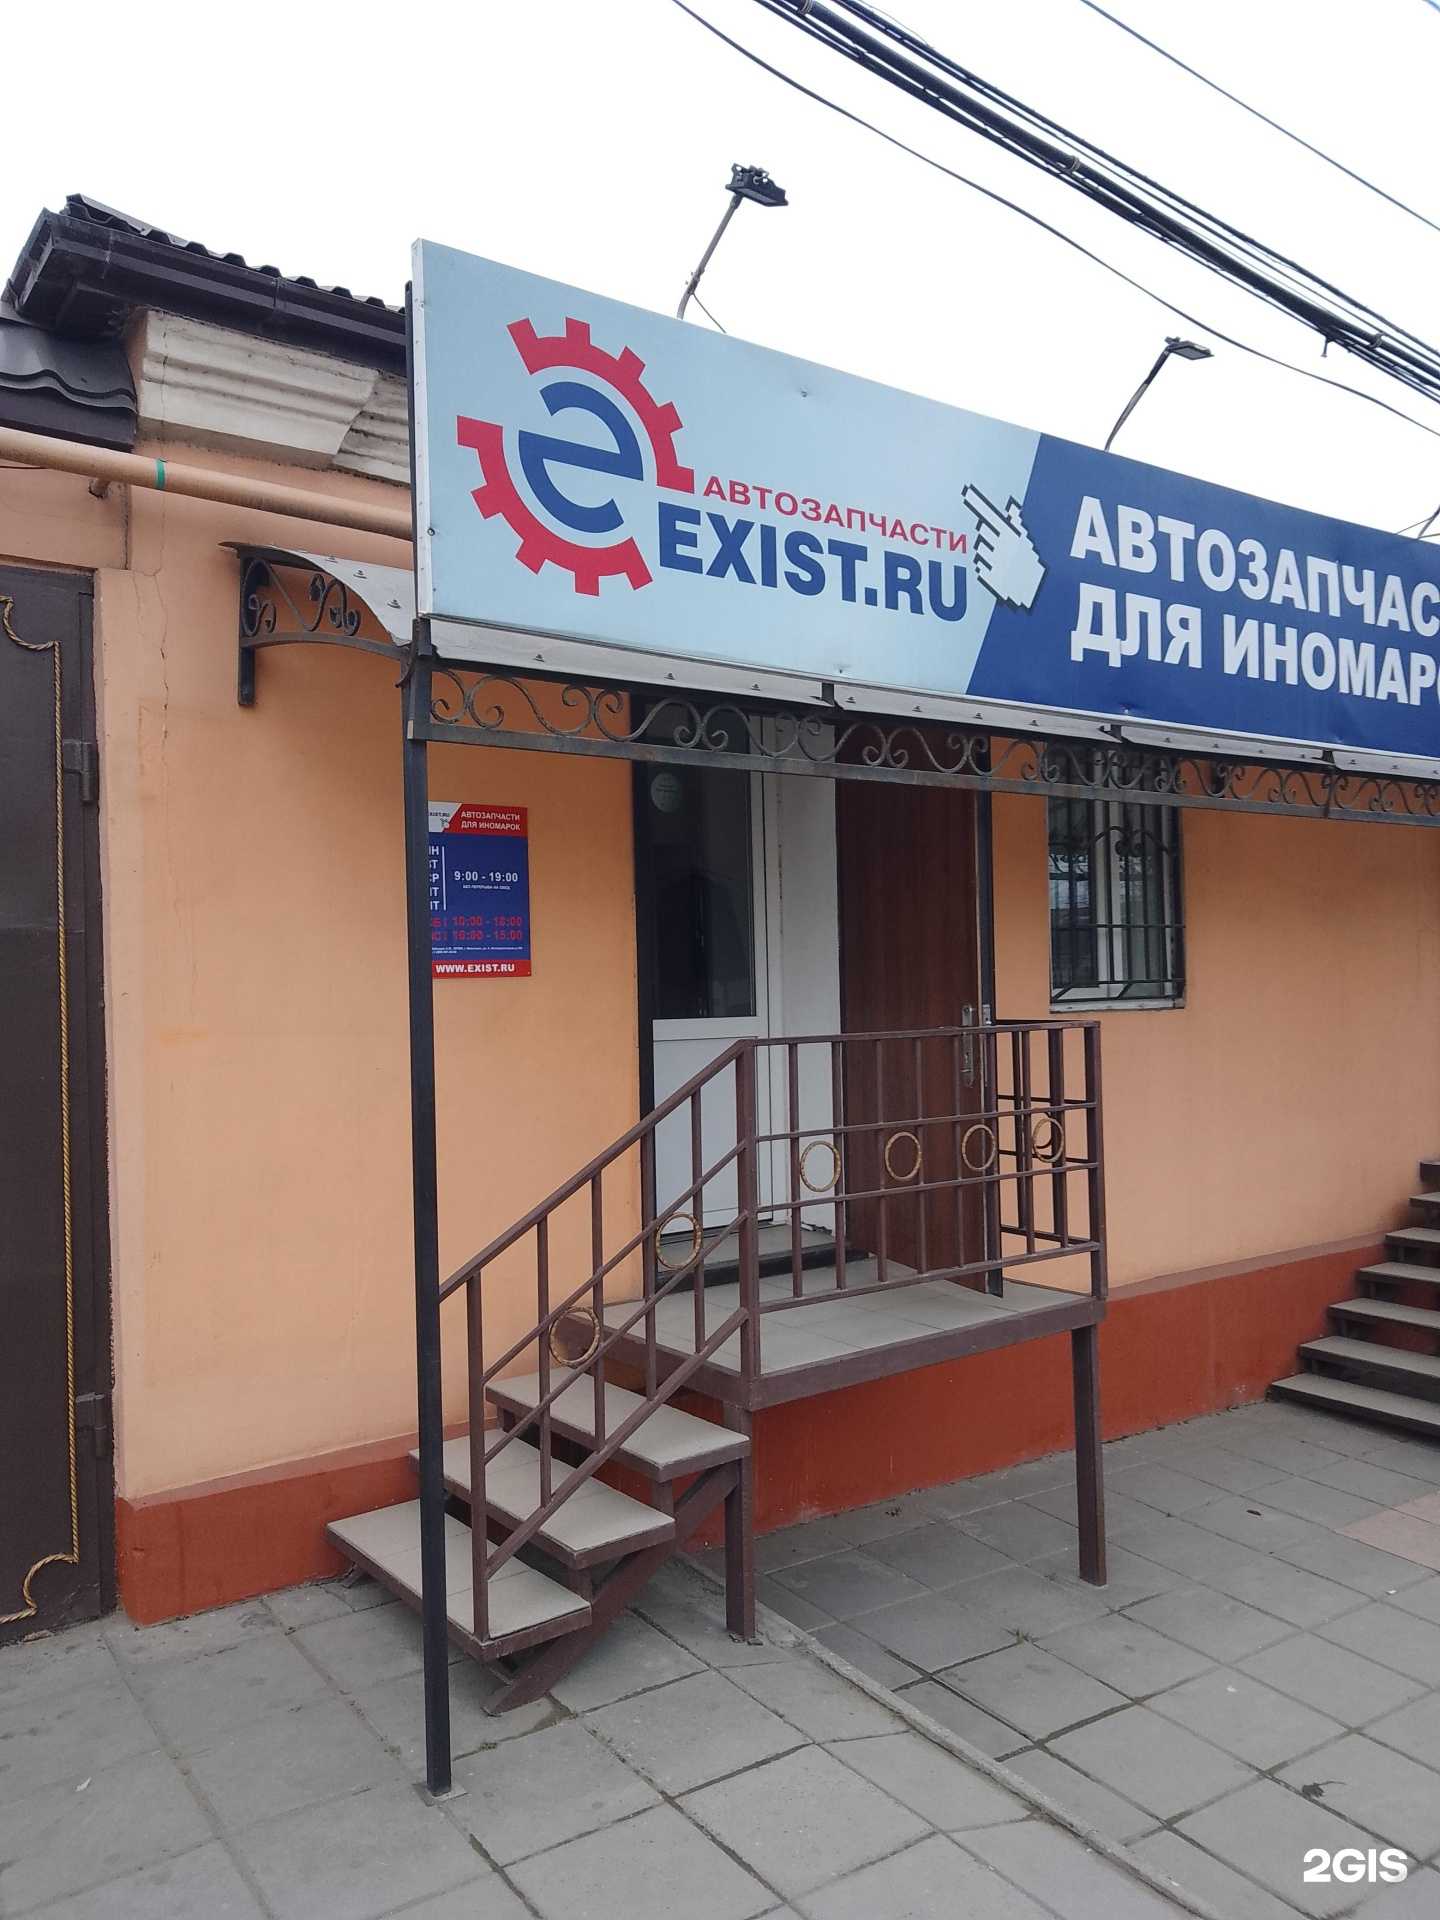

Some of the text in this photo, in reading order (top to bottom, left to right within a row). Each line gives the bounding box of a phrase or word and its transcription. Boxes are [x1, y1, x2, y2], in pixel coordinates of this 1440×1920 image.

[703, 475, 968, 554] АВТОЗАПЧАСТИ
[658, 501, 968, 622] EXIST.RU
[1070, 496, 1440, 637] АВТОЗАПЧАС
[1071, 582, 1440, 706] ДЛЯ ИНОМАР
[461, 811, 520, 821] АВТОЗАПЧАСТИ
[461, 820, 520, 831] ДЛЯ ИНОМАРОК
[454, 871, 478, 881] 9:00
[489, 872, 518, 882] 19:00
[436, 963, 514, 973] WWW.EXIST.RU
